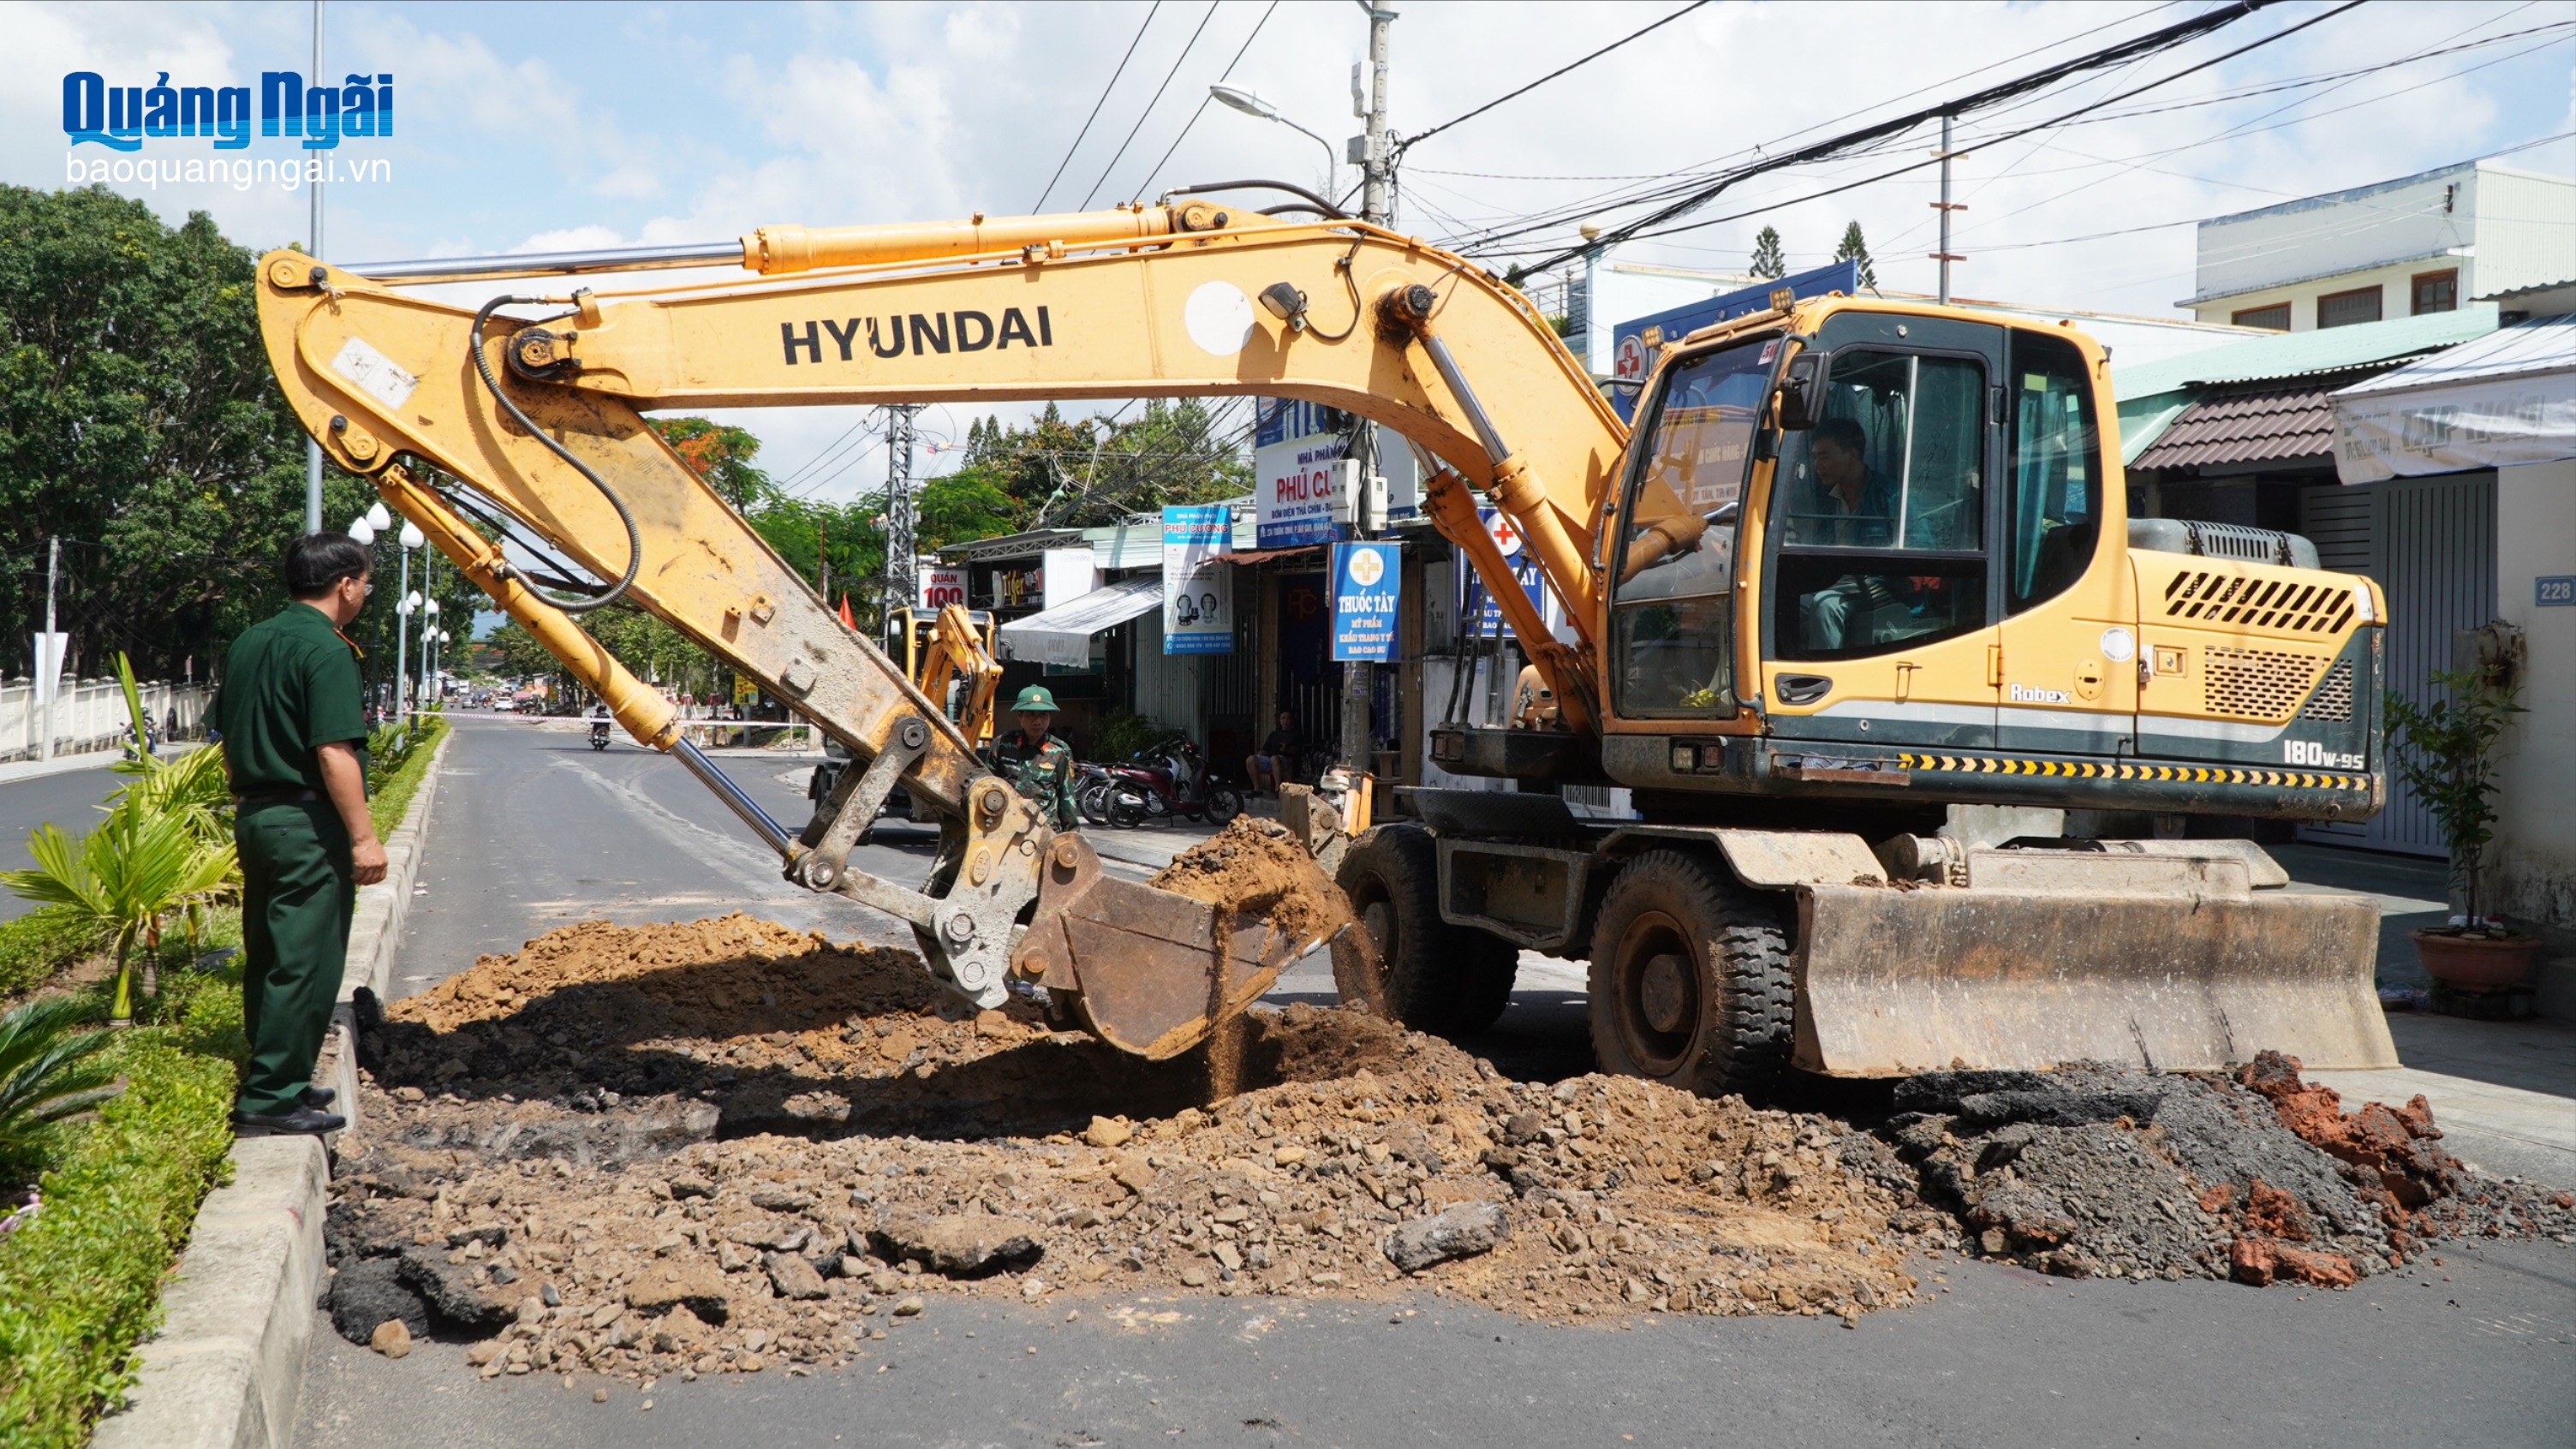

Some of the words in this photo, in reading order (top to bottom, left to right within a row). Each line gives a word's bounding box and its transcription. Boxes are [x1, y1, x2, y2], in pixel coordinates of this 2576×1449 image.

[780, 305, 1052, 366] HYUNDAI
[1297, 448, 1313, 465] NHÀ
[1315, 444, 1338, 462] PHÂN
[1276, 468, 1308, 504] PHÚ
[930, 571, 957, 583] QUÁN
[1002, 569, 1025, 606] Tiger
[924, 587, 963, 608] 100
[1338, 587, 1373, 613] THUỐC
[1374, 591, 1395, 612] TÂY
[2541, 582, 2571, 599] 228
[1380, 633, 1386, 641] Y
[2010, 683, 2072, 704] Robex
